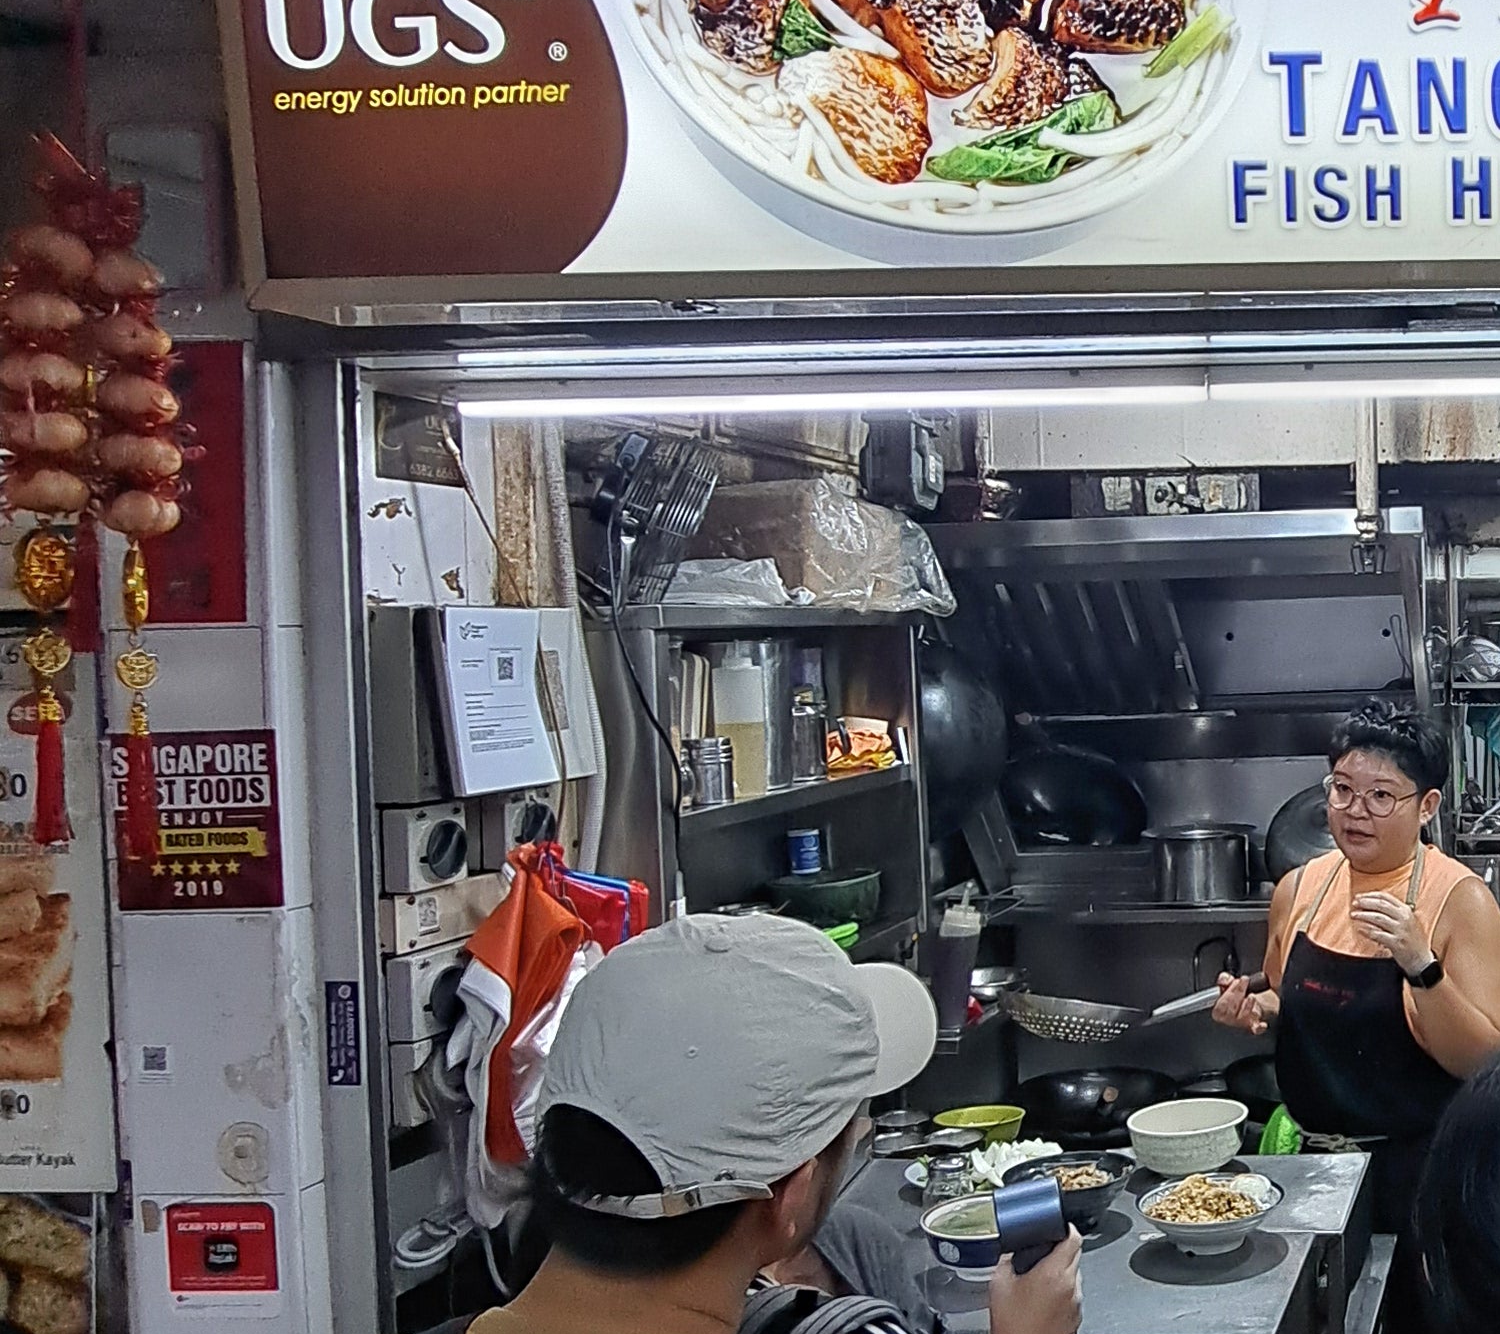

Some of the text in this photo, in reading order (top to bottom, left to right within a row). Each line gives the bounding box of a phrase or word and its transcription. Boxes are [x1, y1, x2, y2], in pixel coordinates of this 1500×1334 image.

[274, 80, 571, 114] energy solution partner
[1232, 159, 1403, 224] FISH
[112, 743, 269, 777] SGAPORE
[185, 777, 266, 805] FOODS
[160, 811, 224, 826] ENJOY
[166, 832, 249, 847] RATED FOODS
[174, 879, 224, 897] 2019
